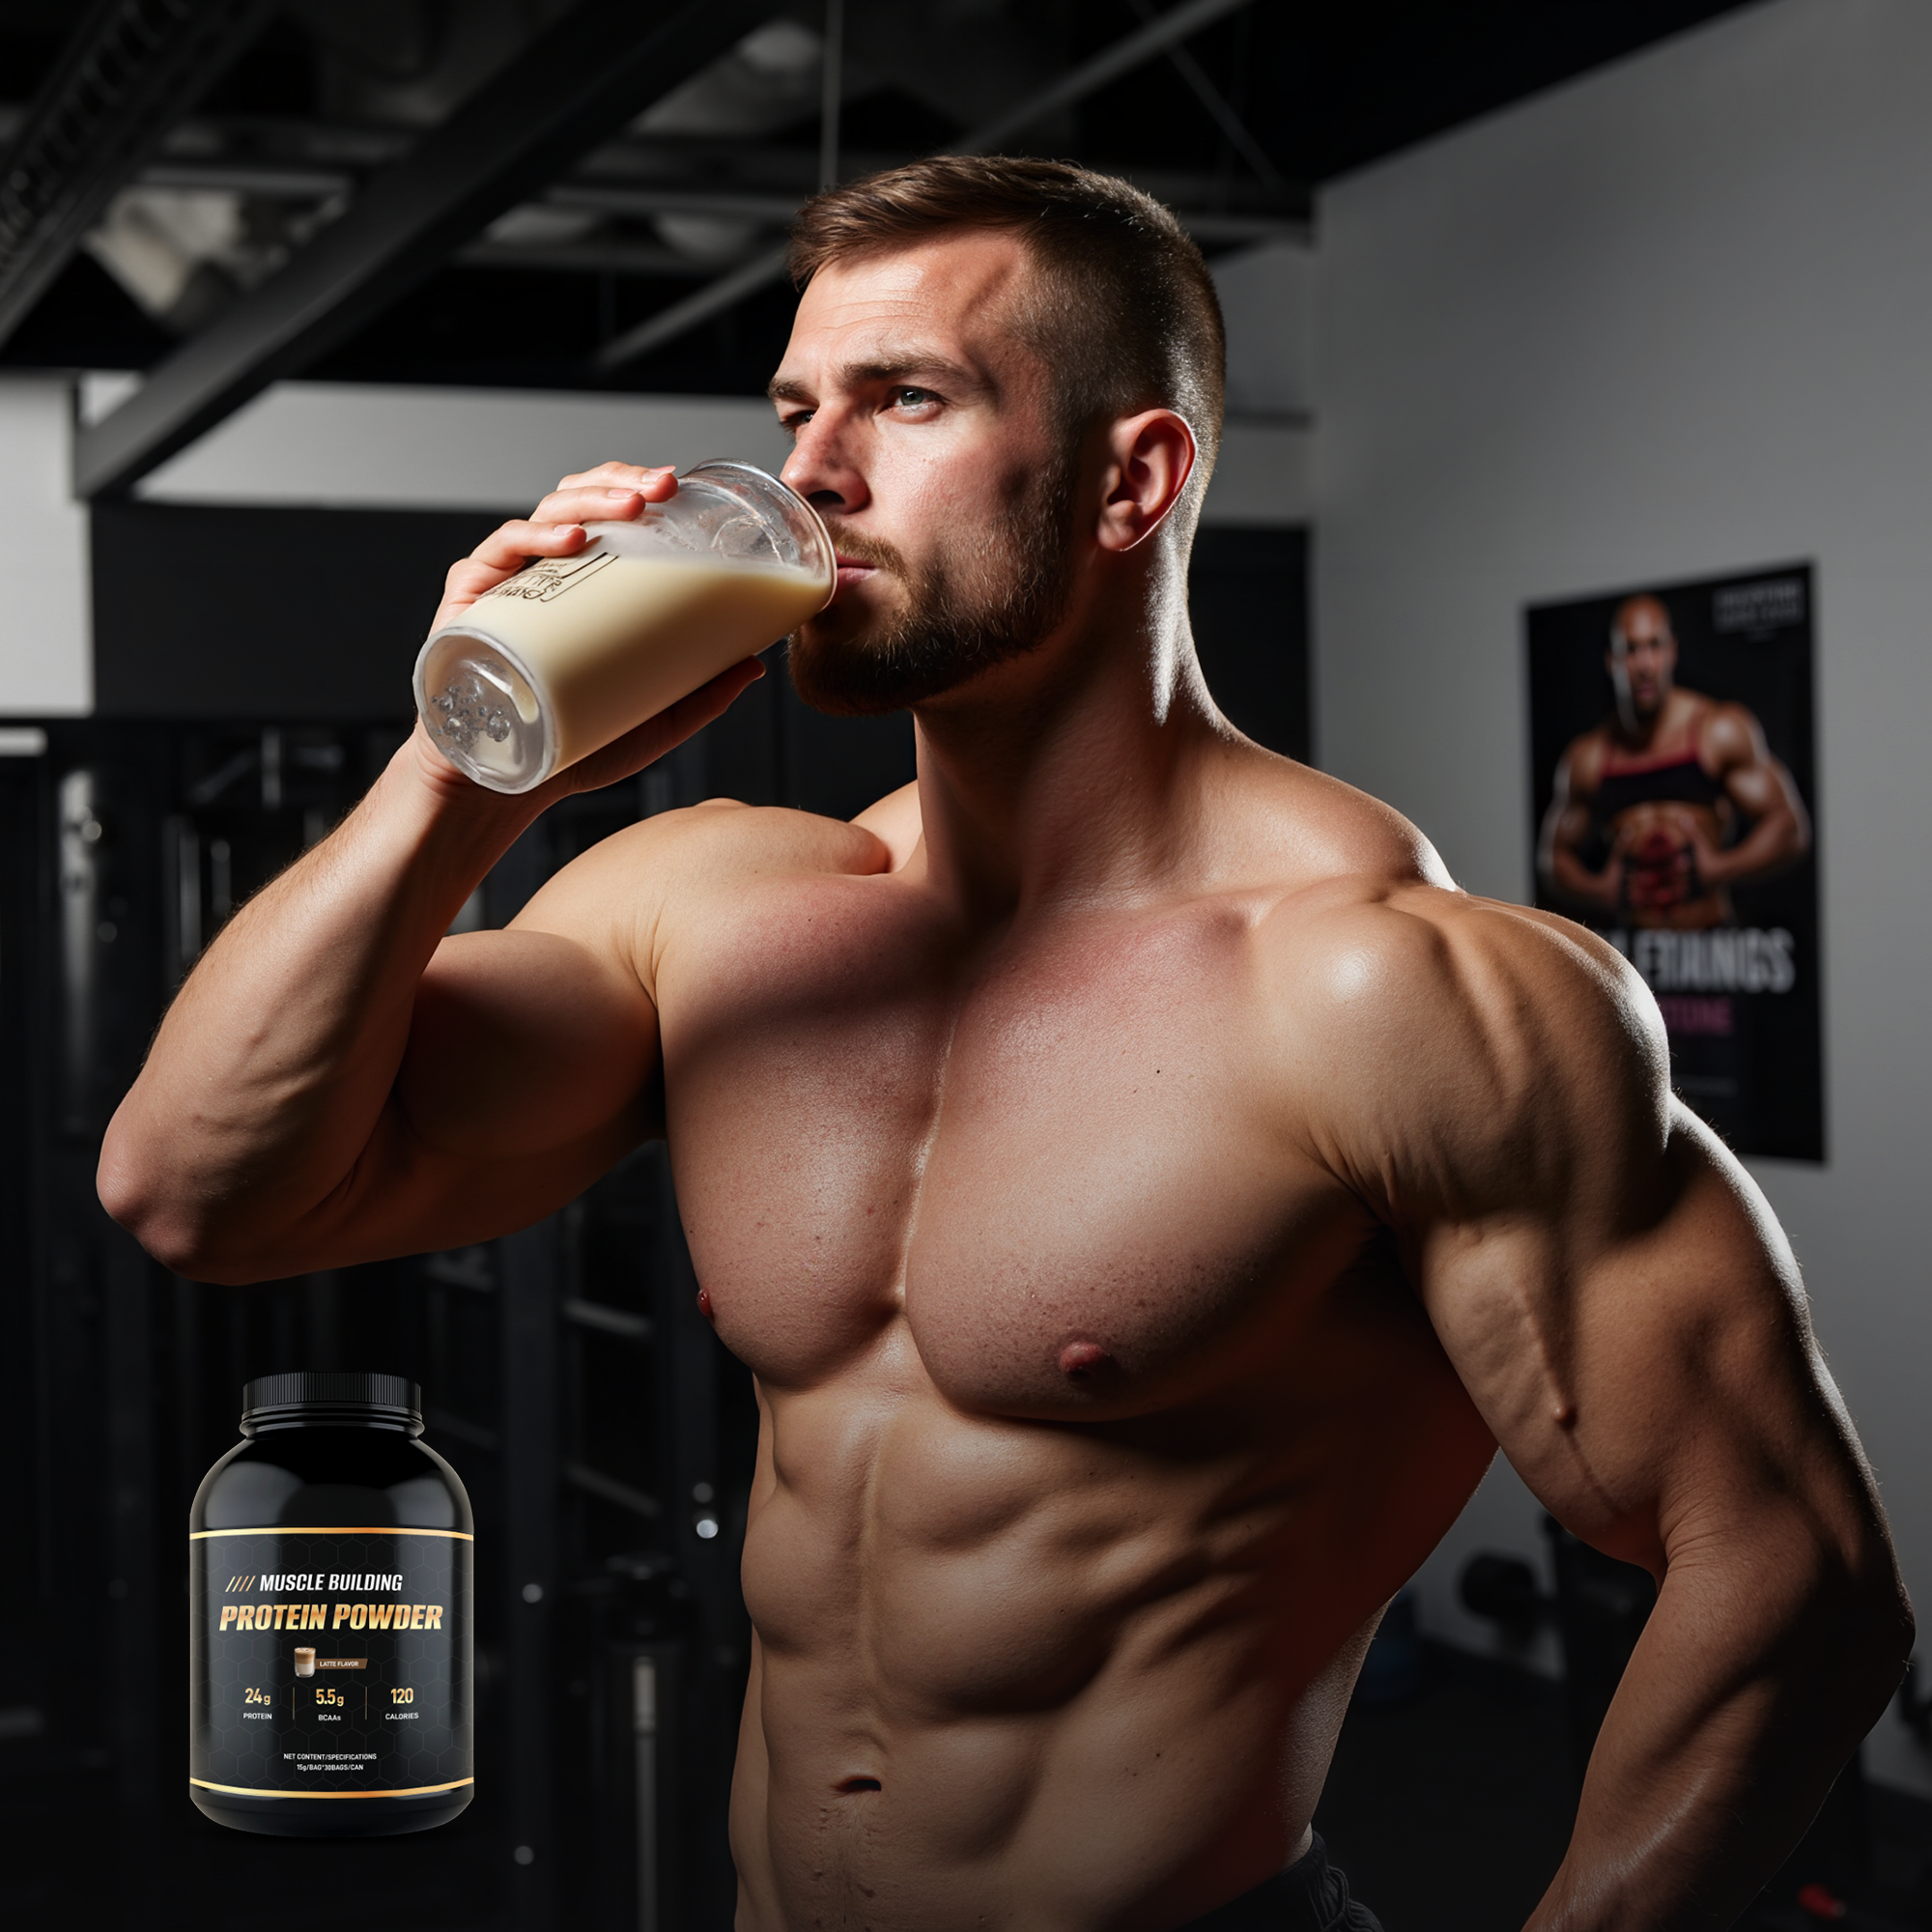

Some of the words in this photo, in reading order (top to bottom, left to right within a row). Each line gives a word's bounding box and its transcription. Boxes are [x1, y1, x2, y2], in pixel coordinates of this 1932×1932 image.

[259, 1574, 325, 1592] MUSCLE
[327, 1574, 403, 1592] BUILDING
[219, 1604, 327, 1632] PROTEIN
[332, 1604, 443, 1631] POWDER
[390, 1688, 414, 1704] 120
[384, 1712, 419, 1720] CALORIES
